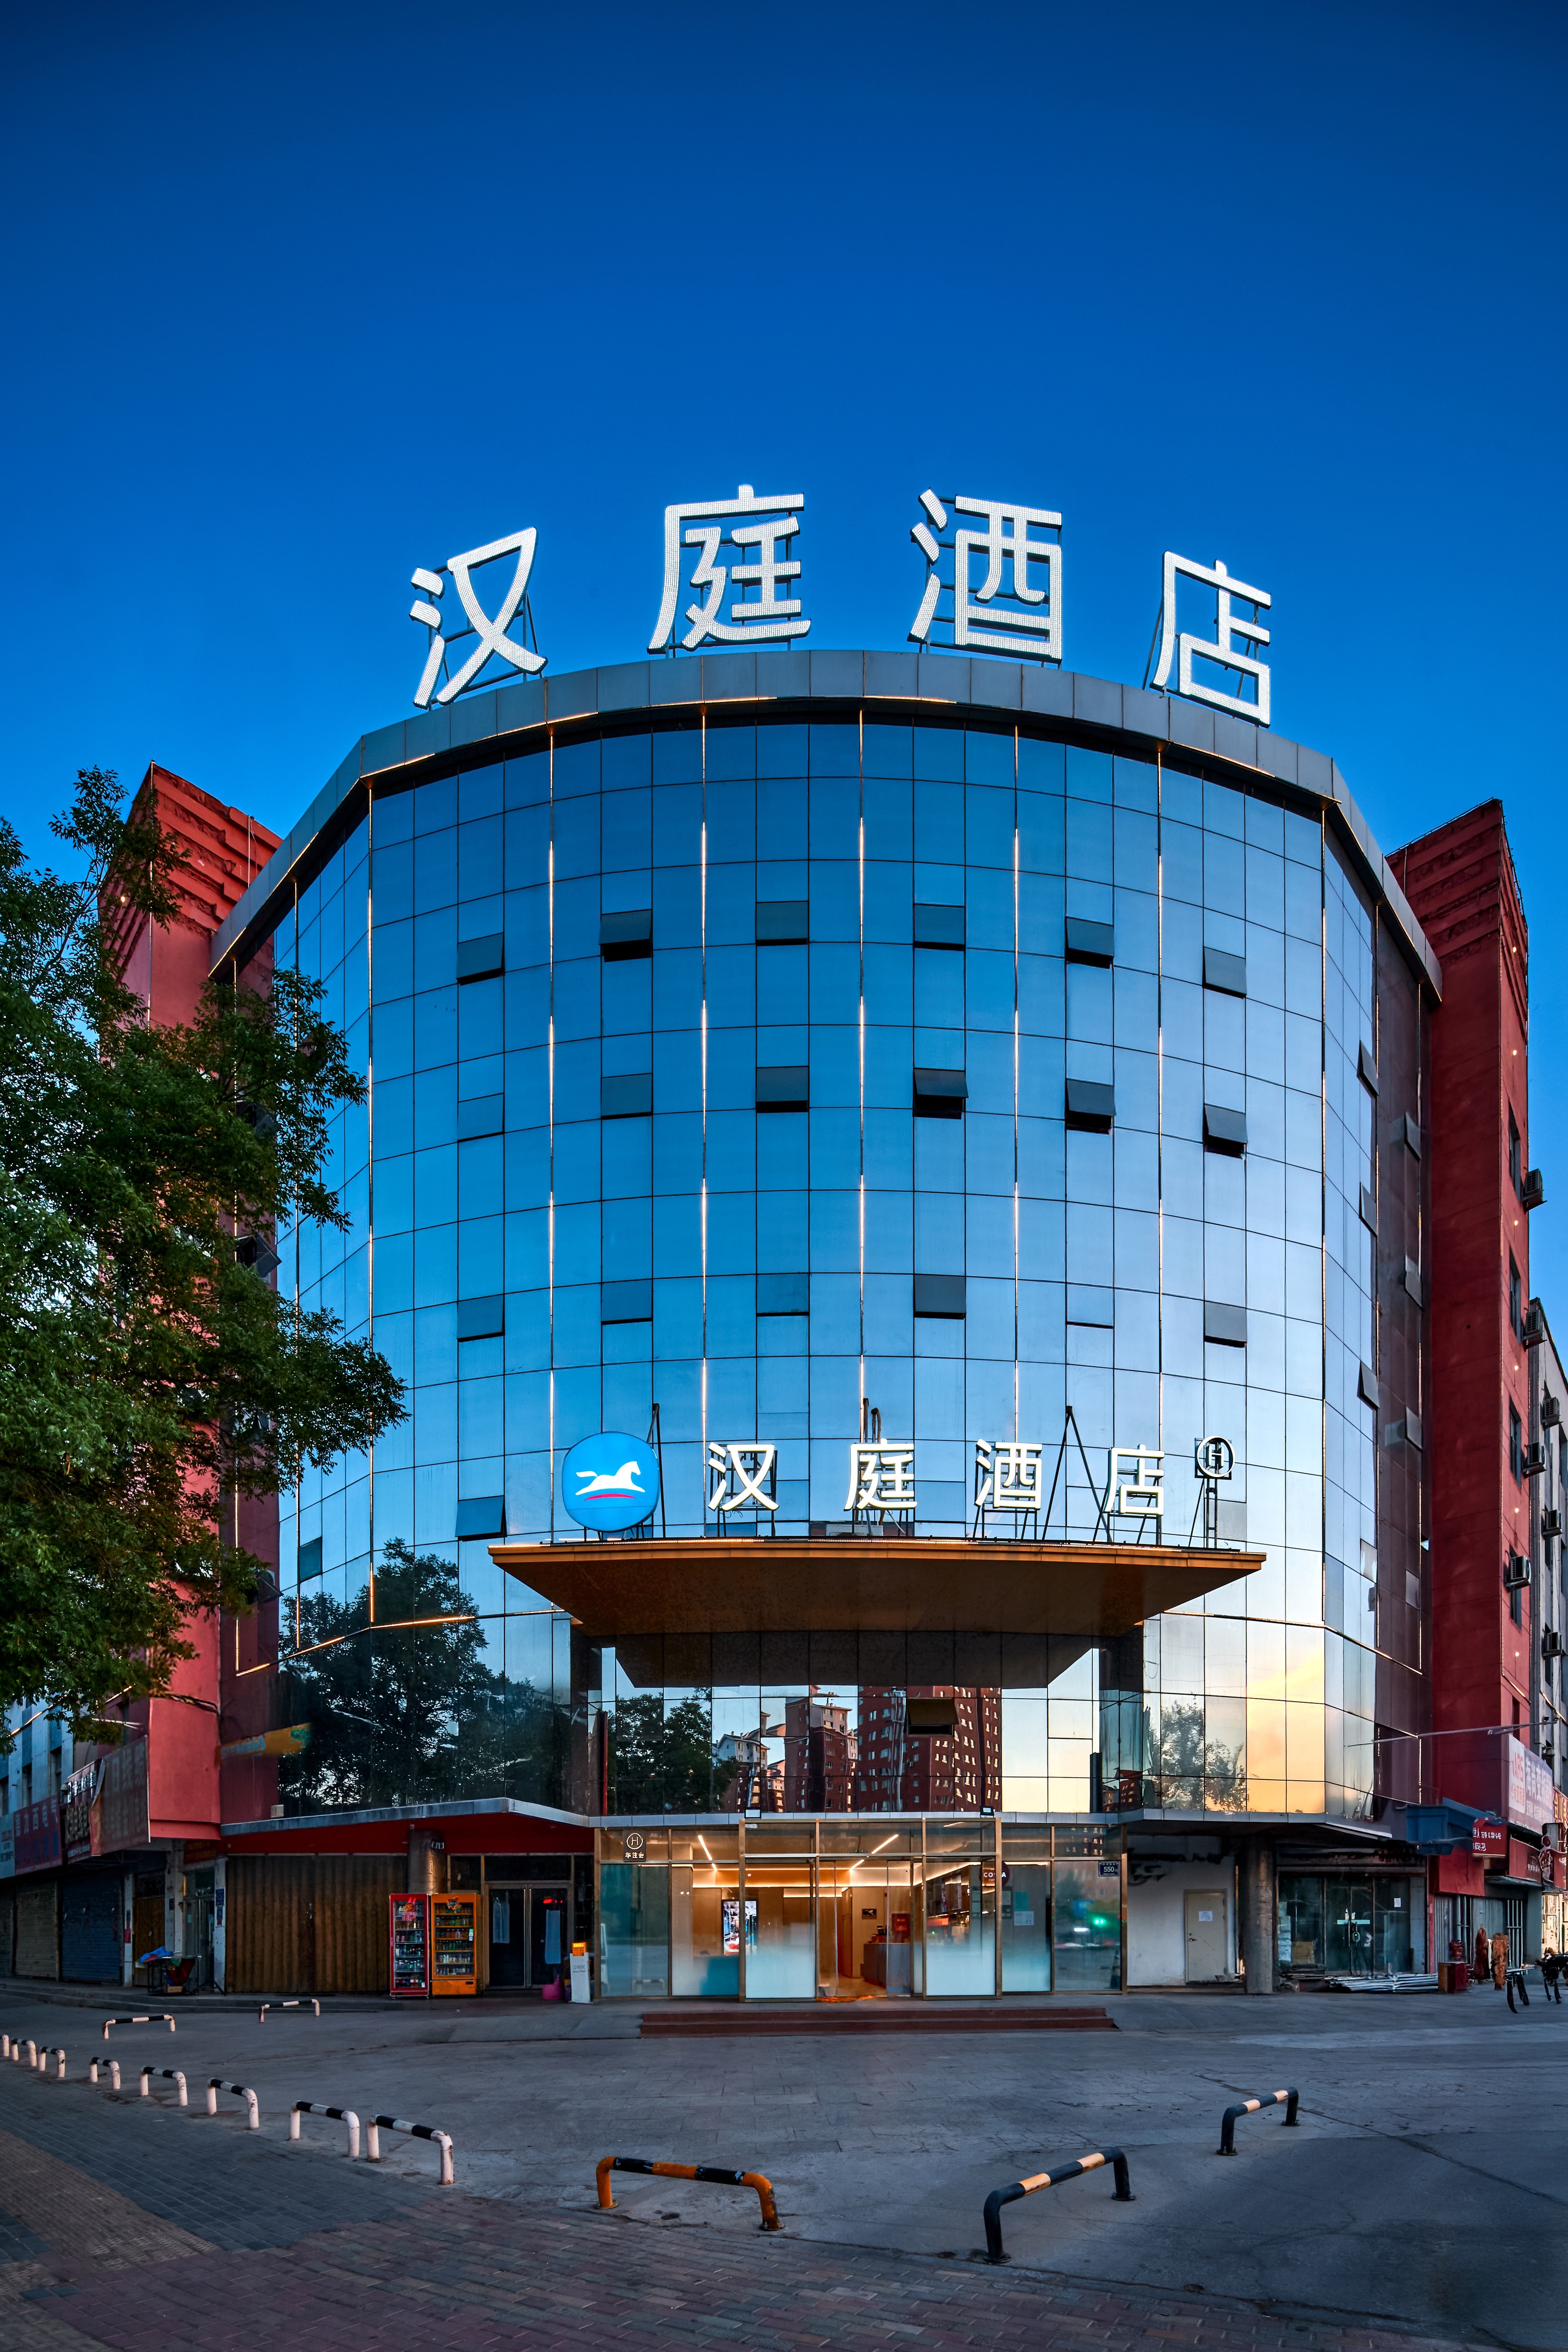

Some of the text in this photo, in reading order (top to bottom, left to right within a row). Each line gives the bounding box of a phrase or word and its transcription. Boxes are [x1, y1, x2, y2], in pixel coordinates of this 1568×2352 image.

[409, 484, 1271, 728] 汉庭酒店
[707, 1438, 1165, 1516] 汉庭酒店
